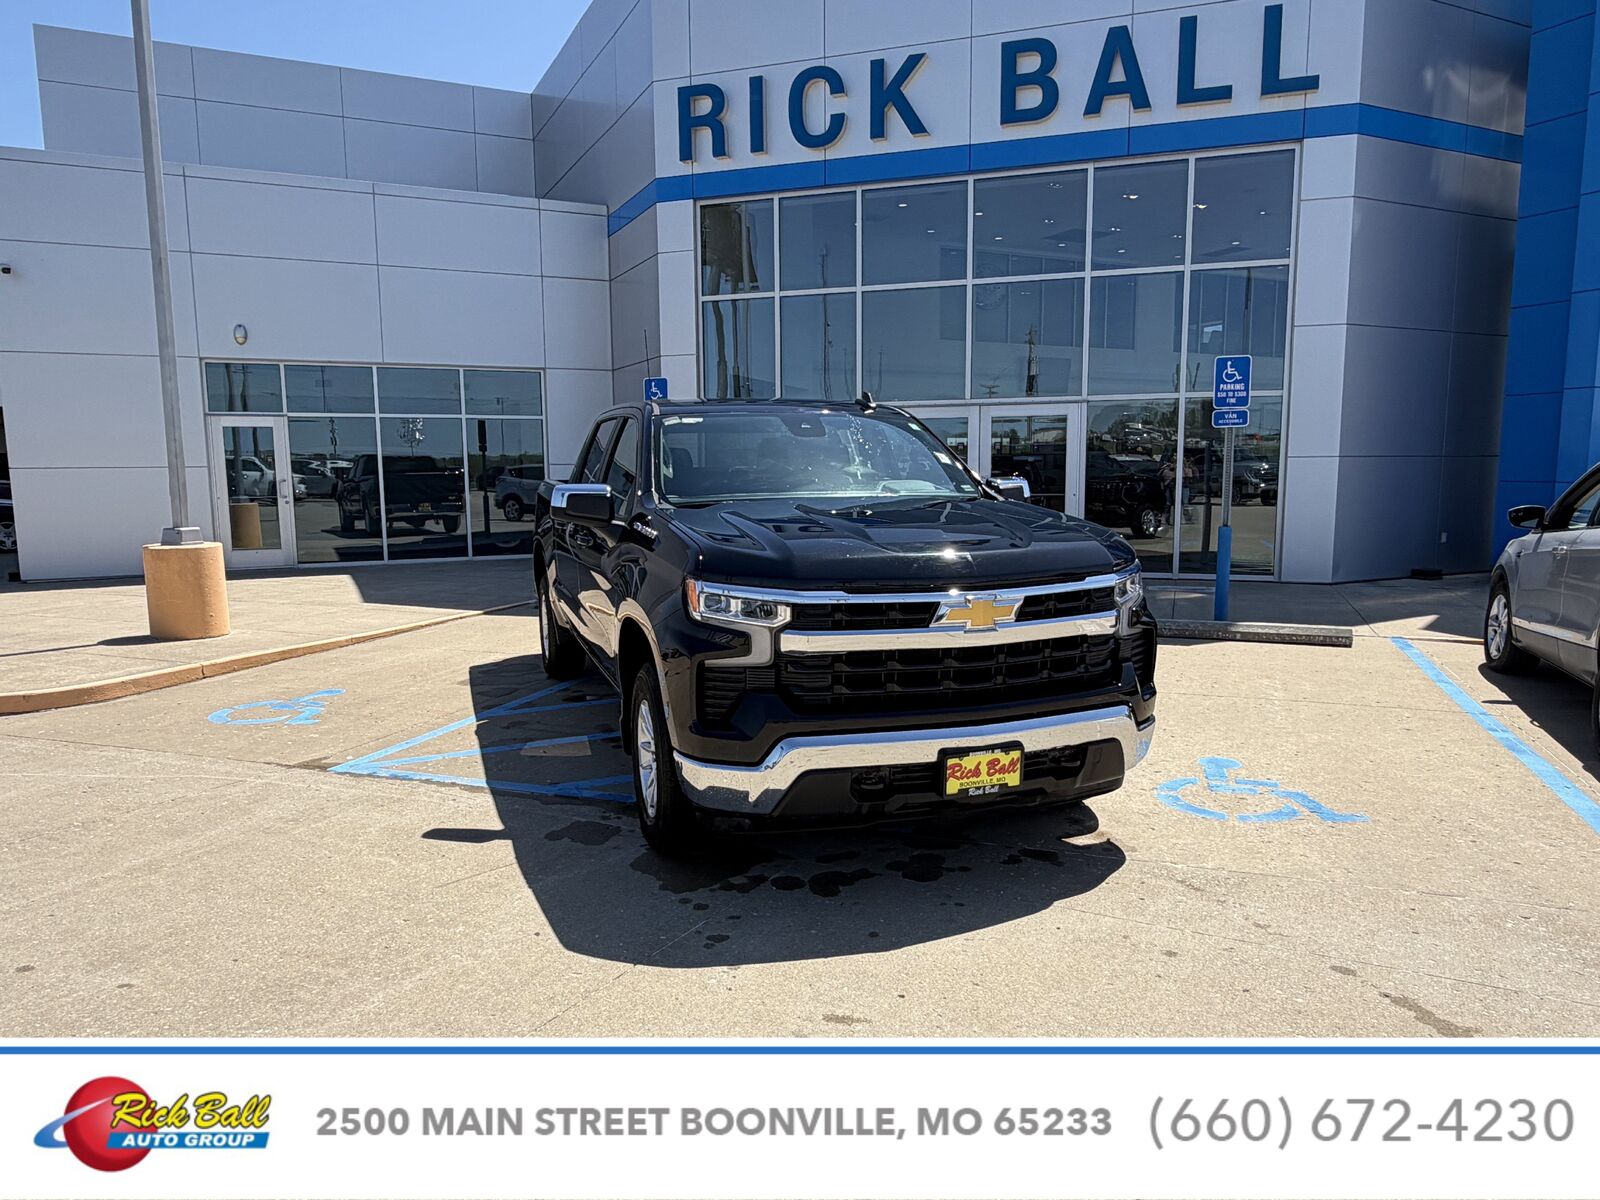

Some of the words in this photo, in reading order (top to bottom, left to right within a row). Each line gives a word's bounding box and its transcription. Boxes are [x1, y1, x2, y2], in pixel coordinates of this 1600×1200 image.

[677, 52, 930, 164] RICK
[1000, 4, 1320, 126] BALL
[1219, 383, 1245, 391] PARKING
[946, 761, 982, 782] Rick
[986, 757, 1019, 777] Ball
[968, 787, 984, 796] Rick
[985, 785, 1000, 793] Ball
